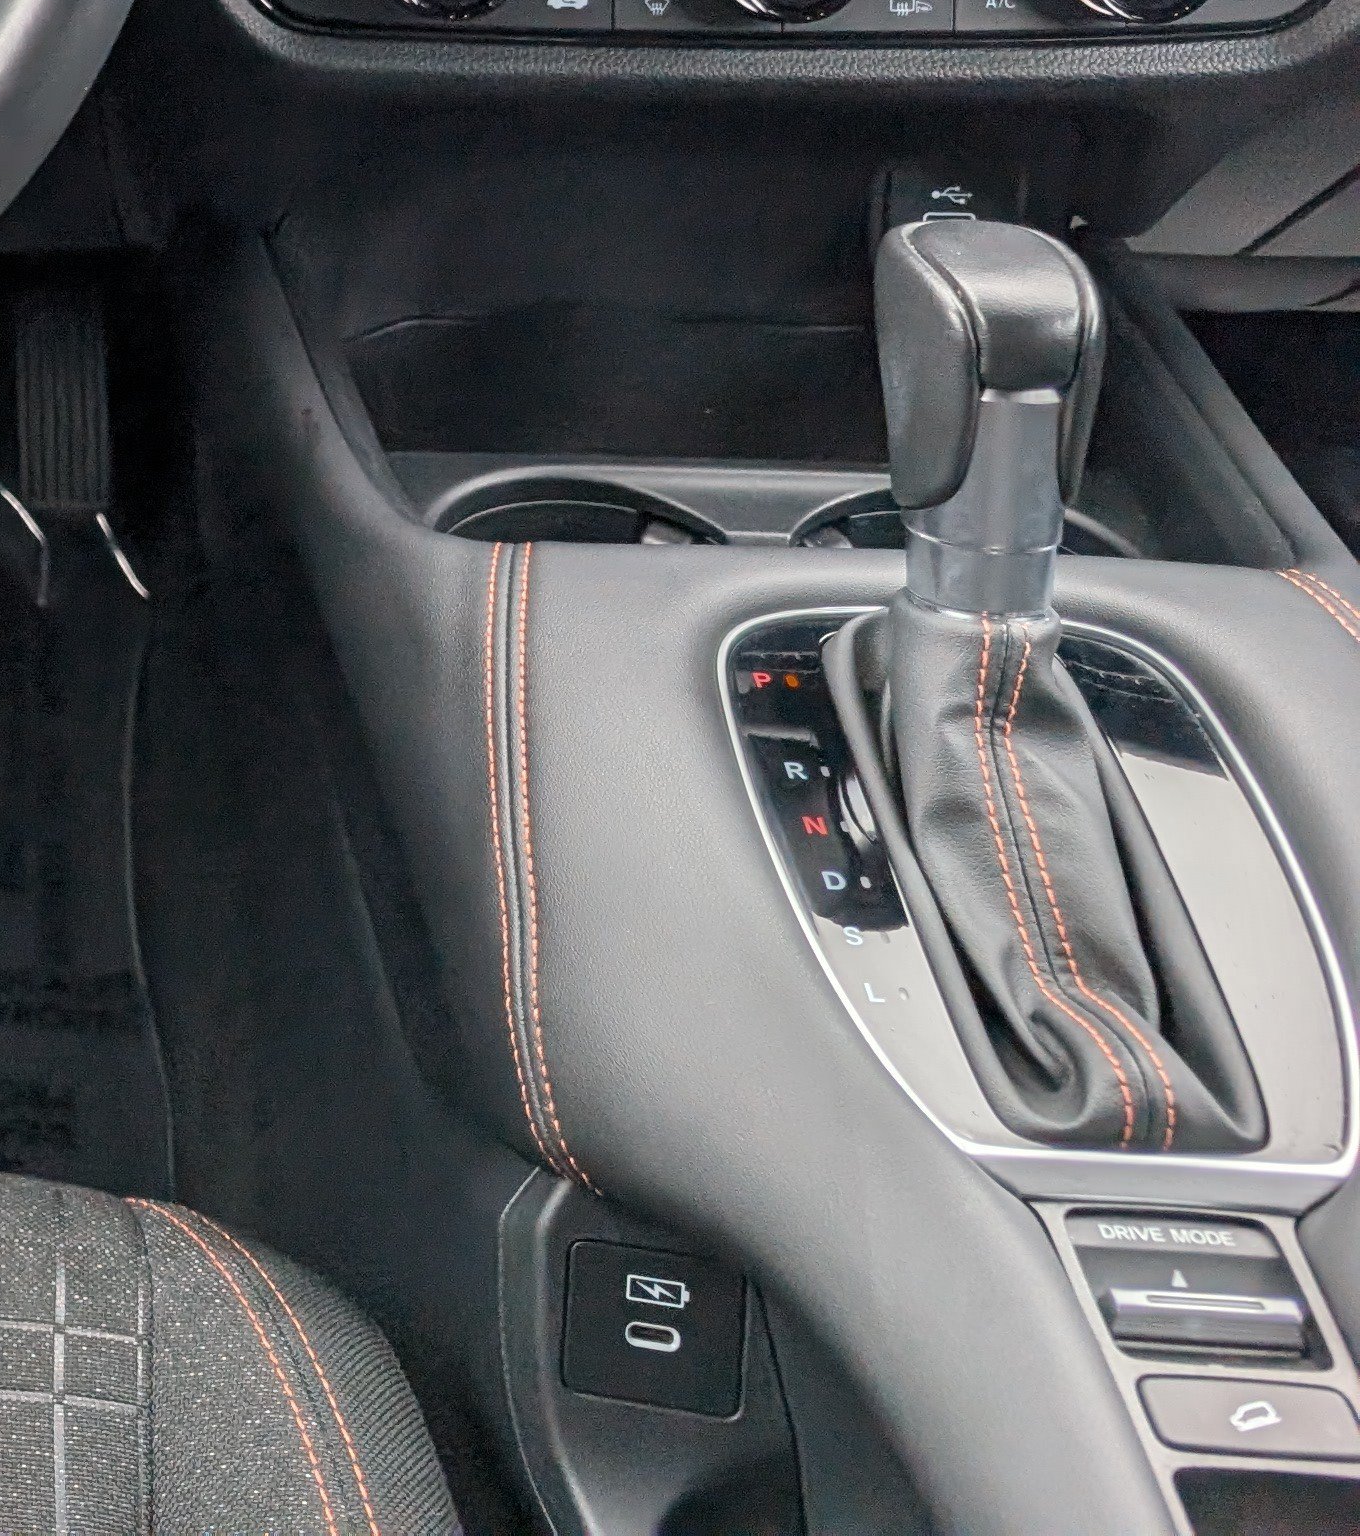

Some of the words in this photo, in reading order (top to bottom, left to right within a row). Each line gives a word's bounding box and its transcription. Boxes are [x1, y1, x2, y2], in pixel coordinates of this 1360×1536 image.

[752, 671, 773, 690] P
[783, 761, 809, 781] R
[801, 815, 829, 836] N
[821, 871, 848, 891] D
[842, 925, 864, 946] S
[863, 982, 886, 1004] L
[1097, 1223, 1165, 1243] DRIVE
[1169, 1227, 1237, 1247] MODE
